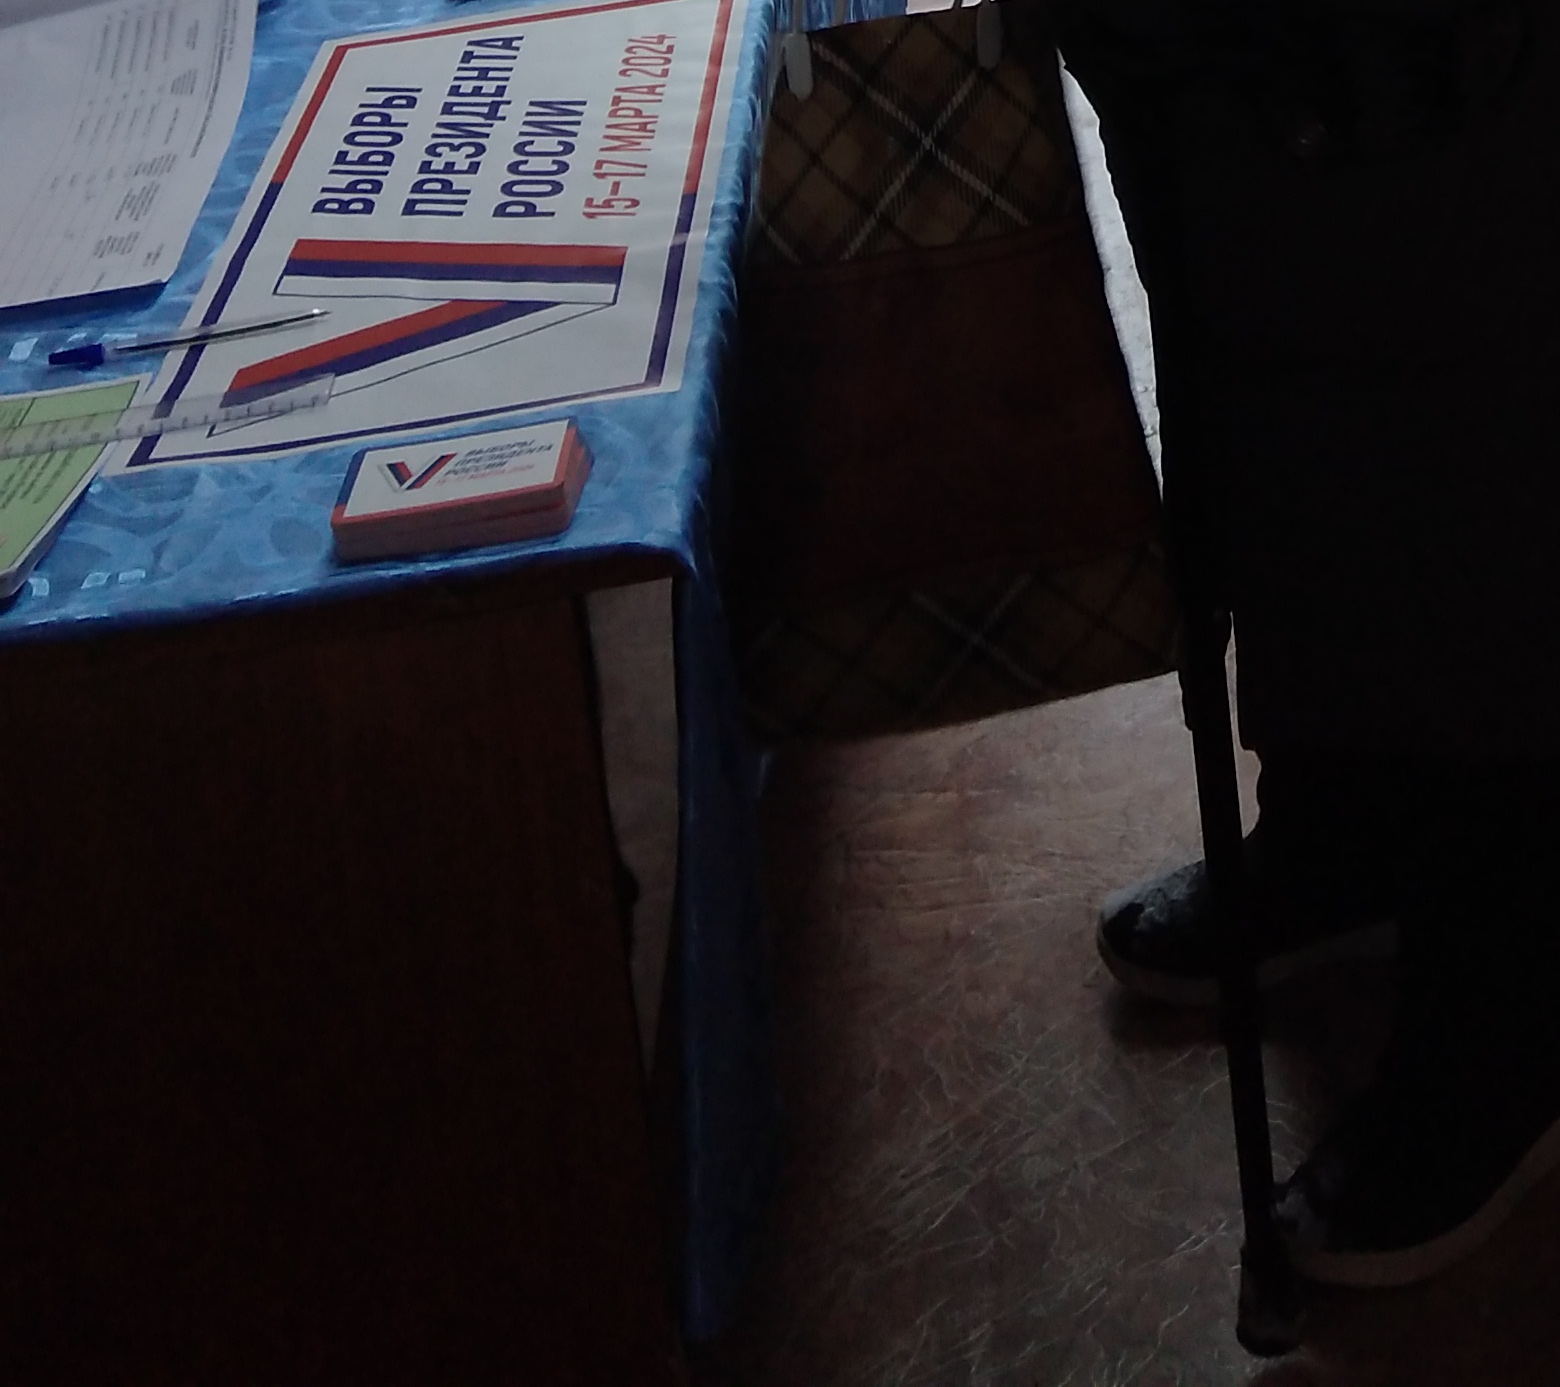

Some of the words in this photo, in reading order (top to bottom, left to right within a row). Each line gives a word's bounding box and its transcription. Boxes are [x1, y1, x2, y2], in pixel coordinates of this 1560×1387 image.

[618, 33, 677, 79] 2024
[311, 86, 423, 215] ВЫБОРЫ
[400, 35, 525, 217] ПРЕЗИДЕНТА
[492, 99, 588, 218] РОССИИ
[598, 84, 667, 152] МАРТА
[582, 159, 648, 219] 15–17
